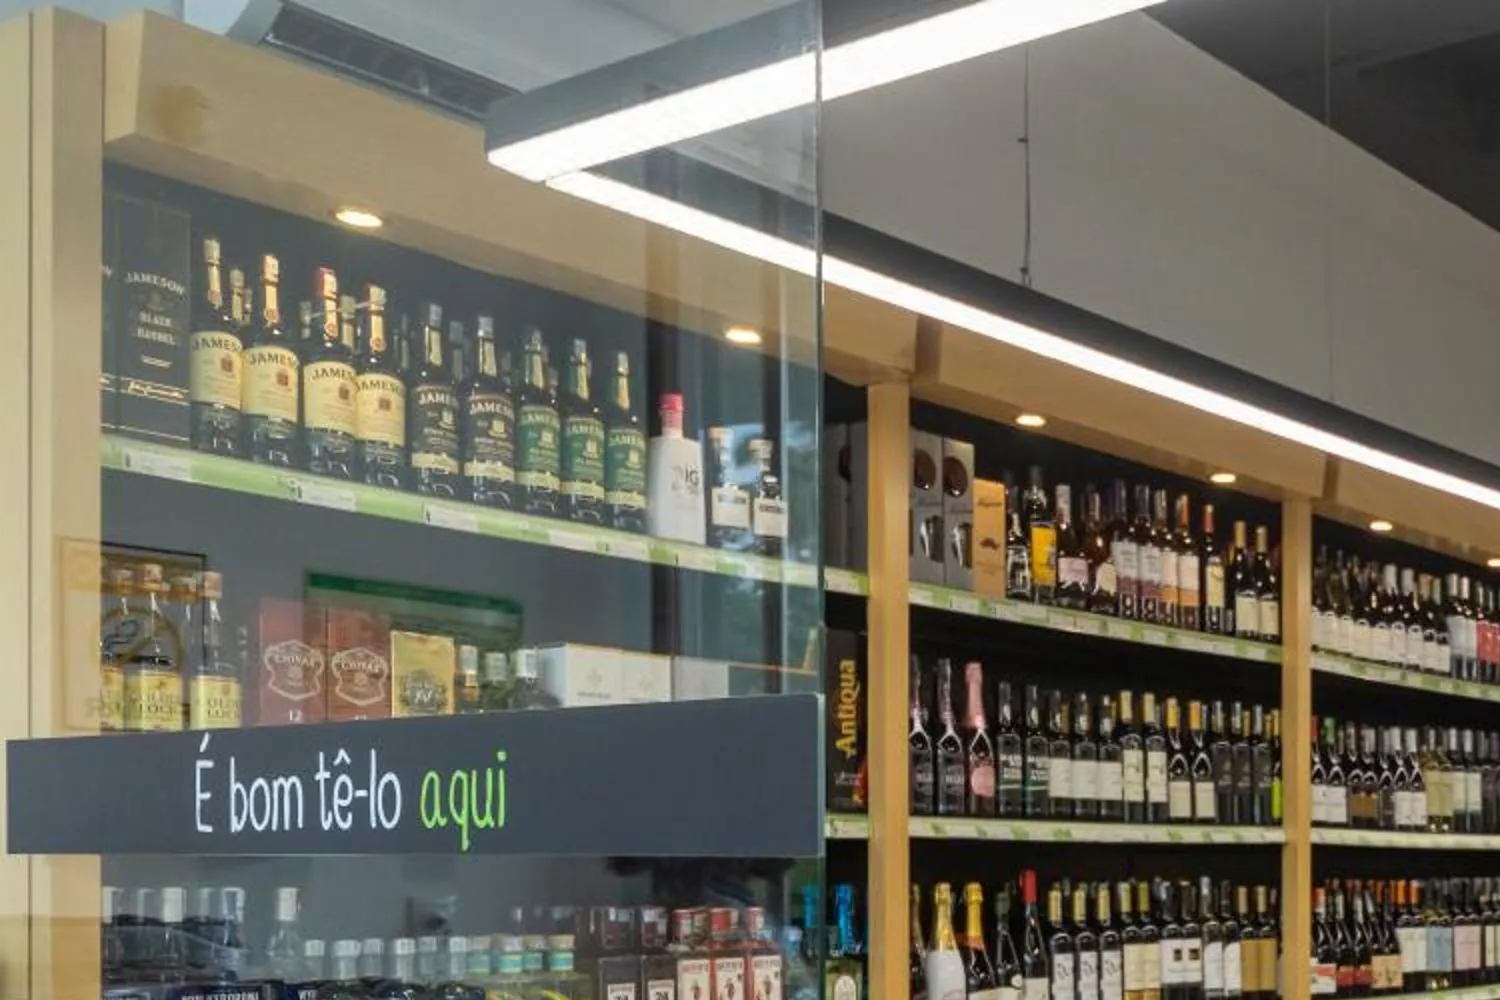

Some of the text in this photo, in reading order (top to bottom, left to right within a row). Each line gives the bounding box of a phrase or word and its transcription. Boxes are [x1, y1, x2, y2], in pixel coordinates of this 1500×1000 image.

[194, 731, 508, 851] É bom tê-lo aqui
